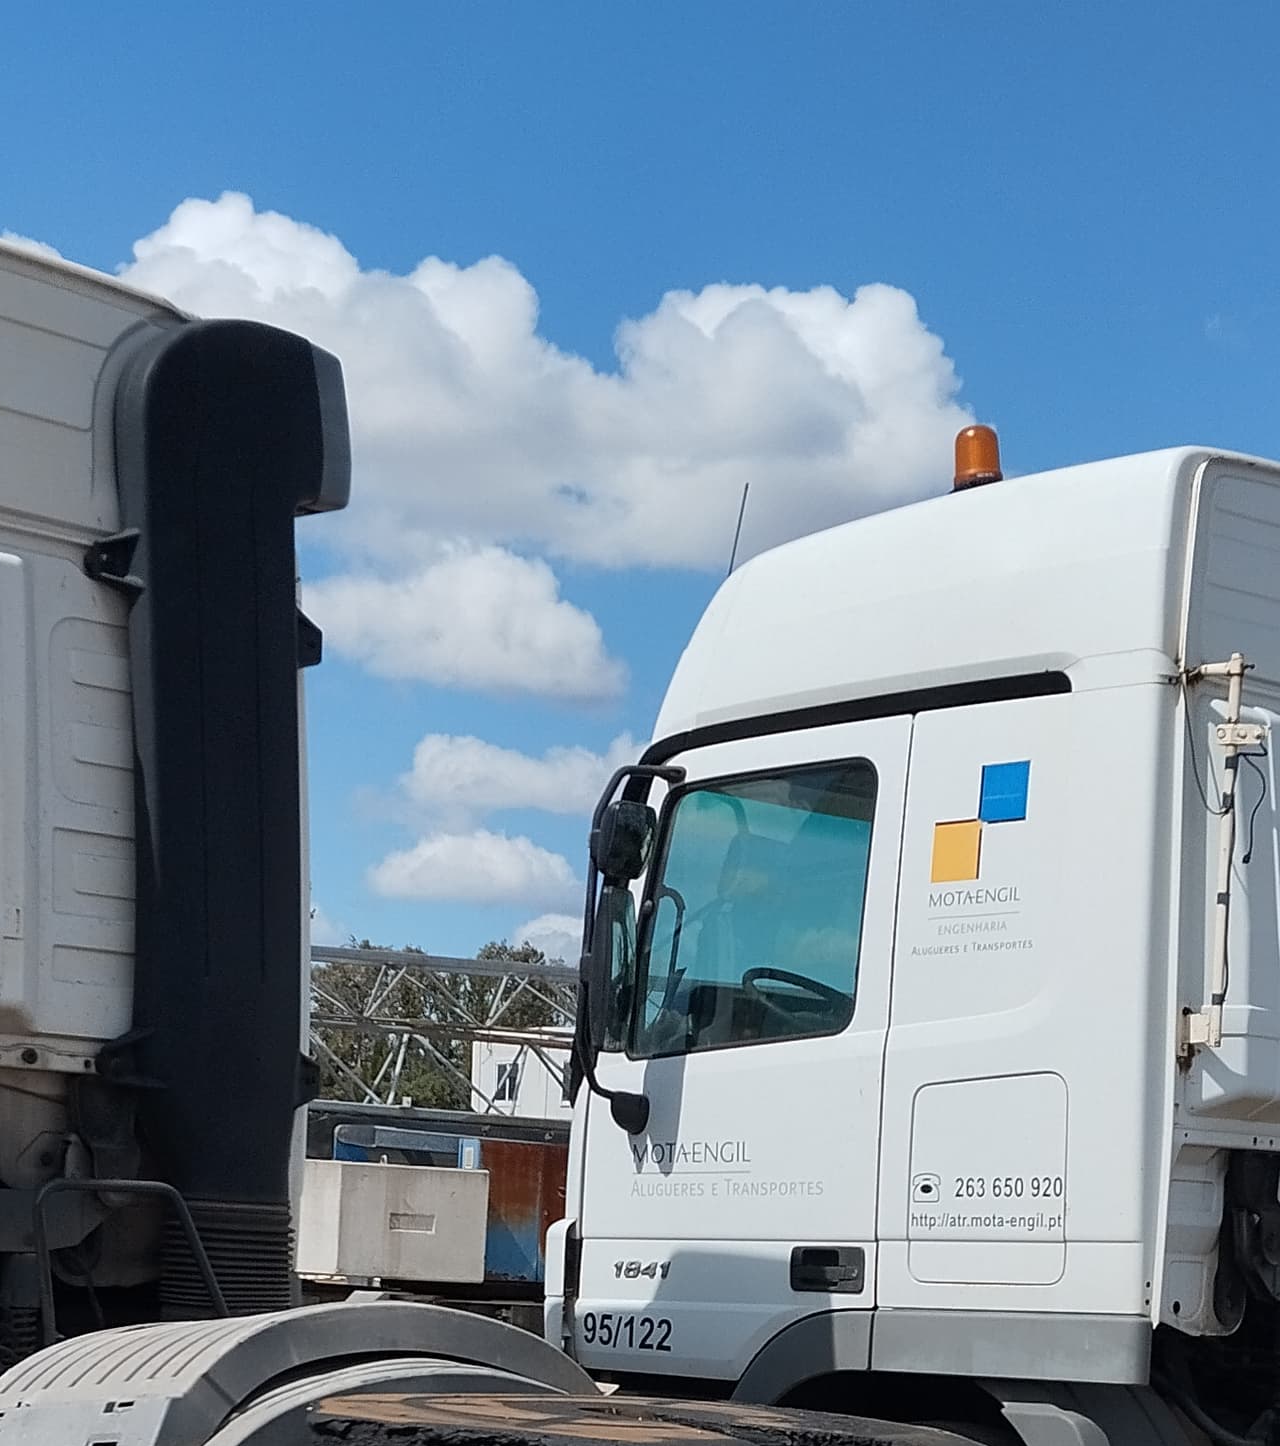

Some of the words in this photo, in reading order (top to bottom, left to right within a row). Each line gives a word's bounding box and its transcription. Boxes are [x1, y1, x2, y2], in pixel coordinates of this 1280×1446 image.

[937, 921, 1008, 936] ENGENHARIA
[954, 1177, 986, 1198] 263
[992, 1177, 1024, 1198] 650
[1031, 1176, 1063, 1198] 920
[911, 1212, 1062, 1231] http://atr.mota-engil.pt
[614, 1261, 671, 1280] 1841
[583, 1311, 673, 1353] 95/122
